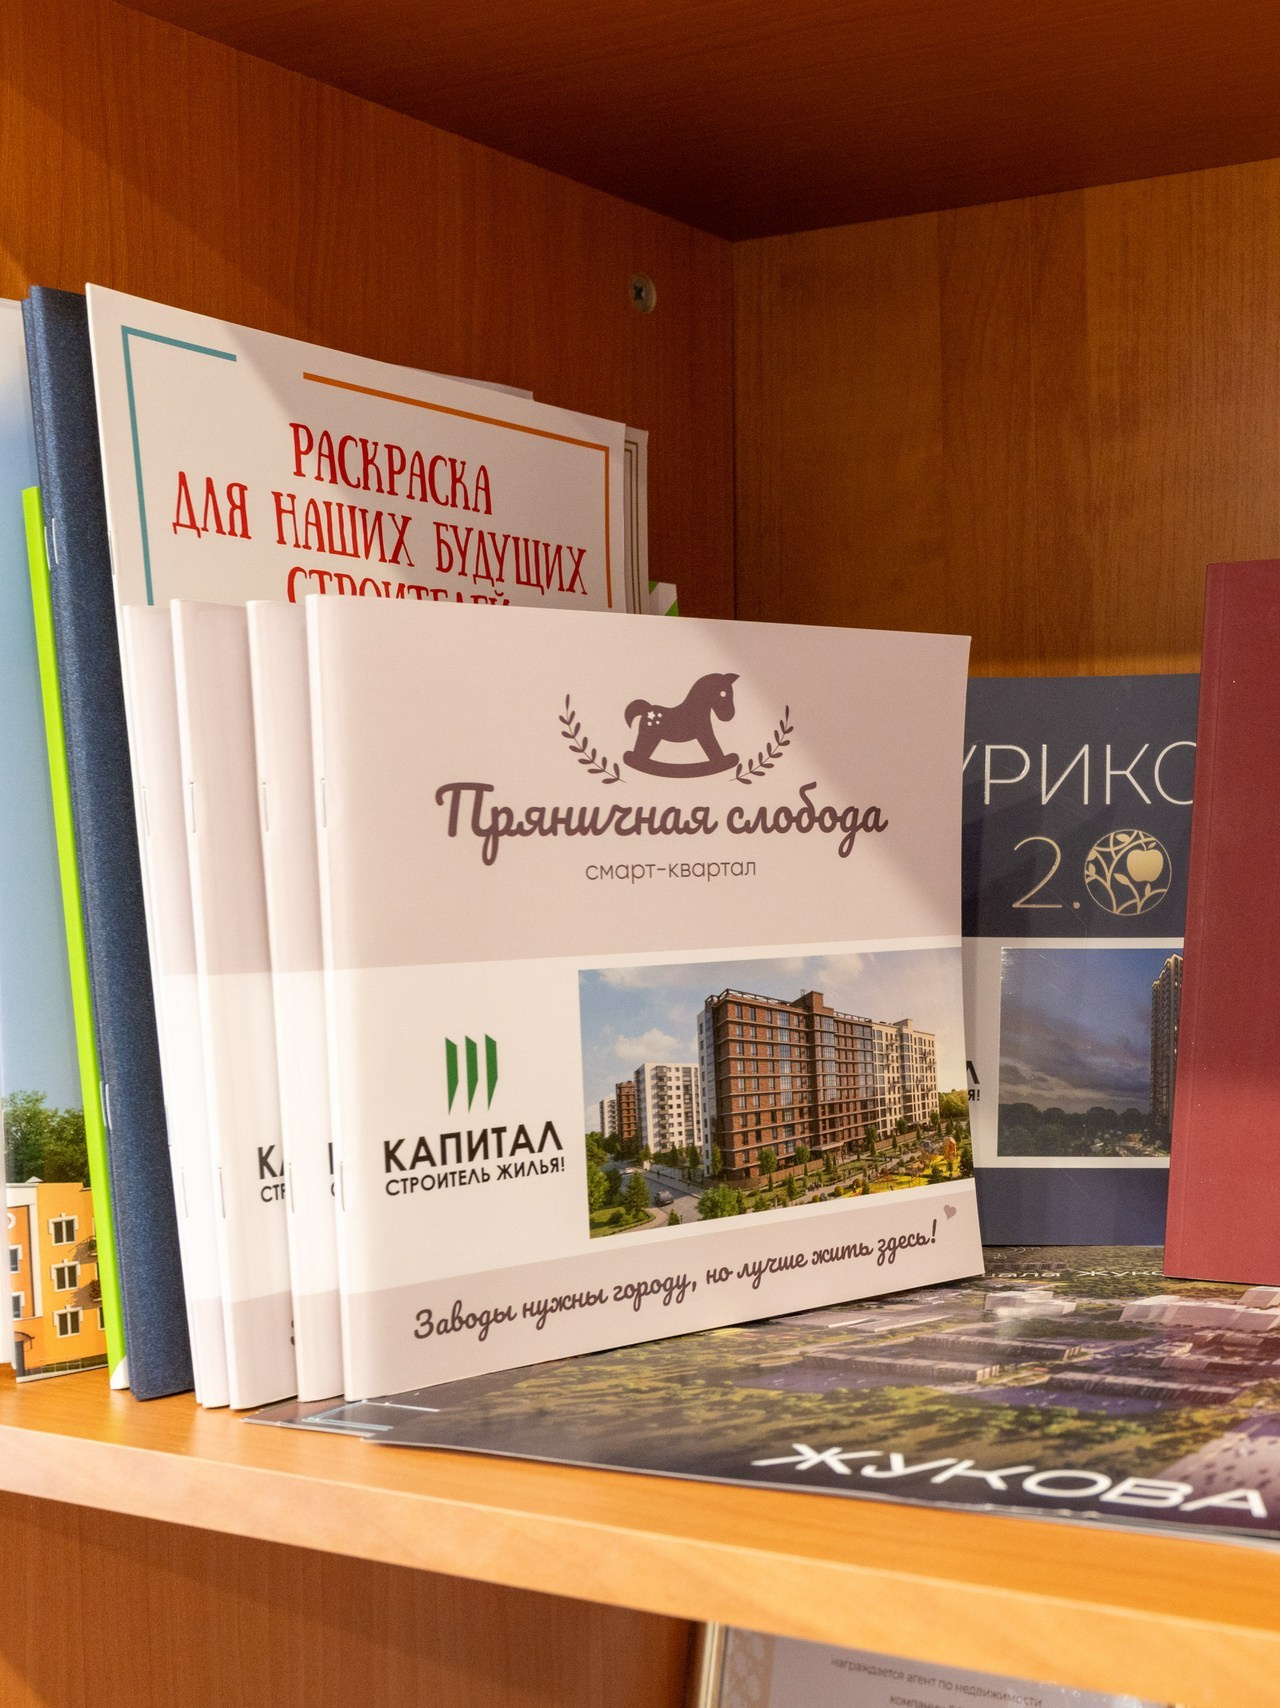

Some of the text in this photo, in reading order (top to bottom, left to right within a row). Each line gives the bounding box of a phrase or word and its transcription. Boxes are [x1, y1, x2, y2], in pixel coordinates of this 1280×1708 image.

[289, 422, 493, 515] РАСКРАСКА
[172, 471, 252, 539] ДЛЯ
[271, 490, 415, 567] НАШИХ
[433, 521, 588, 595] БУДУЩИХ
[434, 780, 889, 866] Пряничная слобода
[585, 859, 757, 884] смарт-квартал
[383, 1120, 564, 1174] КАПИТАЛ
[385, 1156, 566, 1196] СТРОИТЕЛЬ ЖИЛЬЯ!
[413, 1218, 939, 1342] Заводы нужны городу, но лучше жить здесь!
[751, 1443, 1268, 1520] ЖУКОВА
